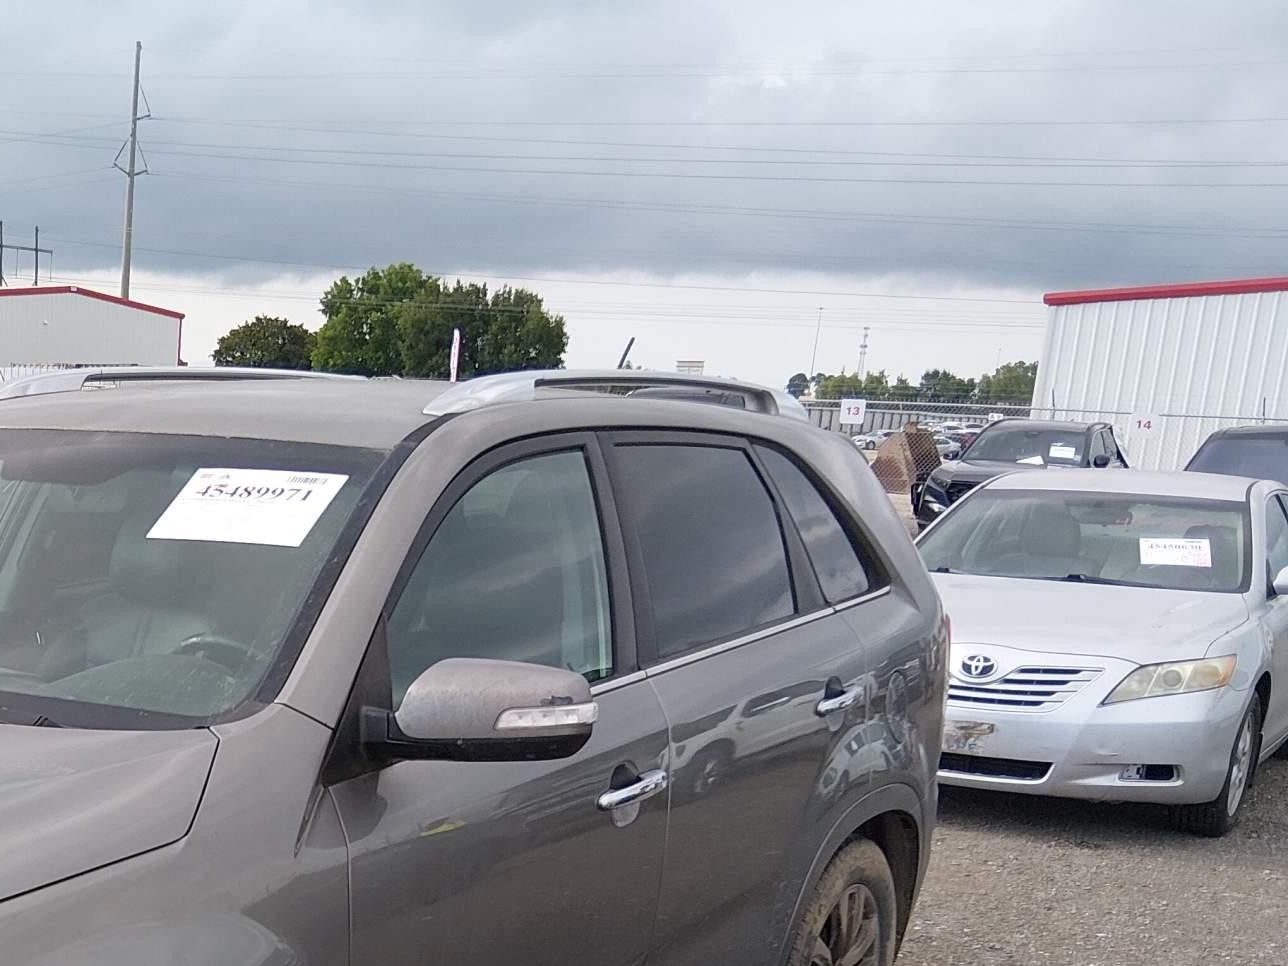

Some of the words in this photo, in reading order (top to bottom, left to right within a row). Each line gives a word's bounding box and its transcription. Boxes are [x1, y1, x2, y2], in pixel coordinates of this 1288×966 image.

[846, 406, 860, 416] 13
[1136, 419, 1152, 430] 14
[195, 483, 314, 502] 45489971
